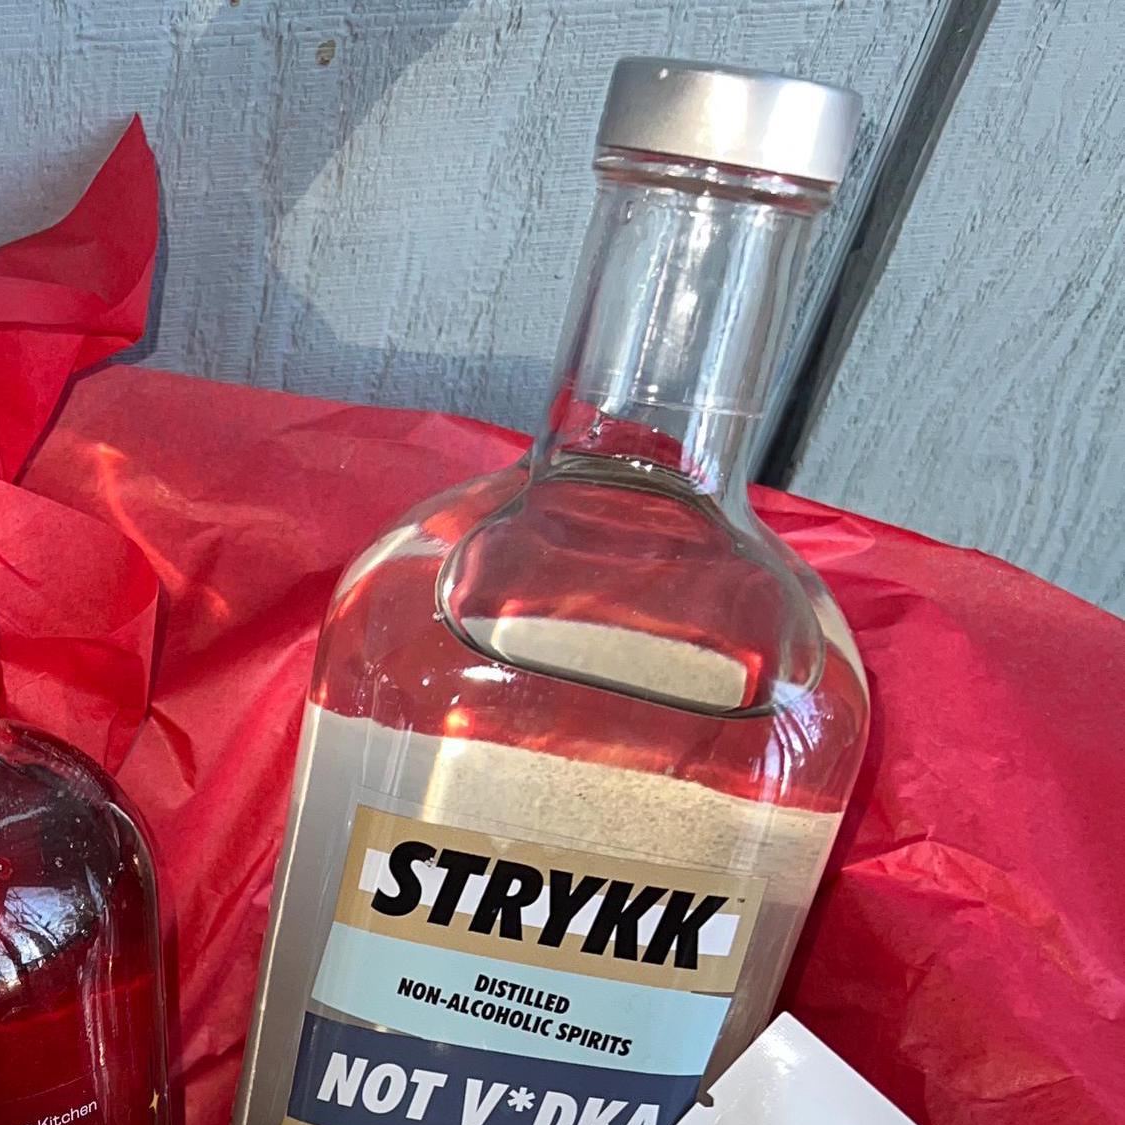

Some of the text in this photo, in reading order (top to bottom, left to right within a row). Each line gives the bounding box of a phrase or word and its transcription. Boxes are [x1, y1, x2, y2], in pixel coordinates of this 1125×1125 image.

[371, 841, 729, 970] STRYKK
[397, 977, 633, 1057] NON-ALCOHOLIC SPIRITS
[473, 974, 570, 1014] DISTILLED
[316, 1052, 448, 1121] NOT
